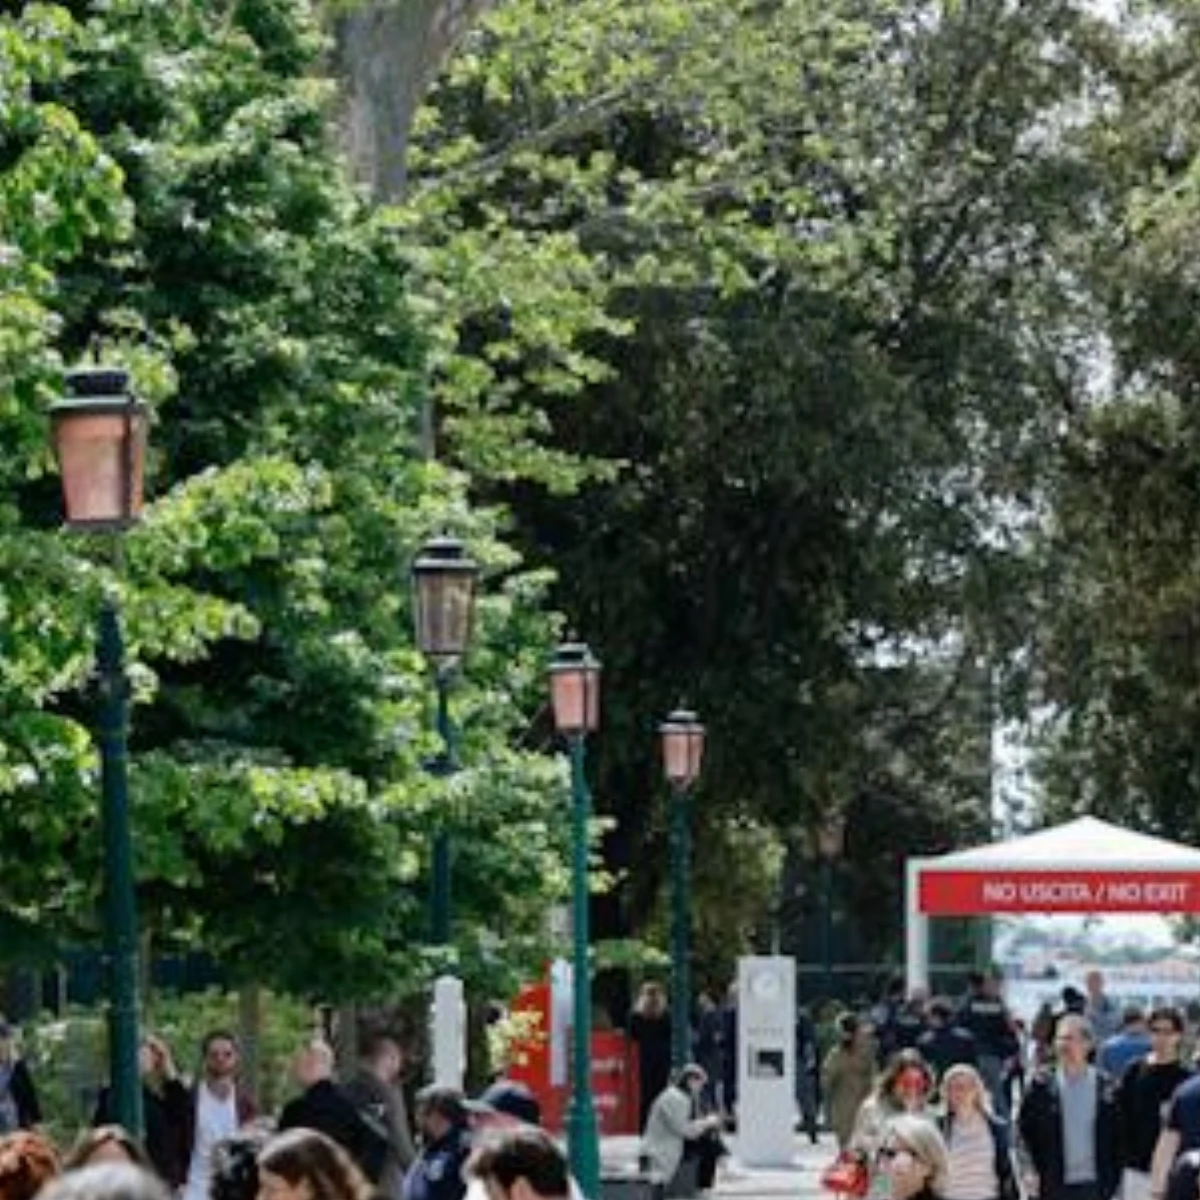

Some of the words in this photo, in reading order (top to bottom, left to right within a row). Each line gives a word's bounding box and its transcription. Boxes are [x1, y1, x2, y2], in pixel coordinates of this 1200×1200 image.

[983, 882, 1016, 903] NO
[1020, 882, 1091, 903] USCITA
[1107, 882, 1140, 903] NO
[1144, 882, 1188, 903] EXIT
